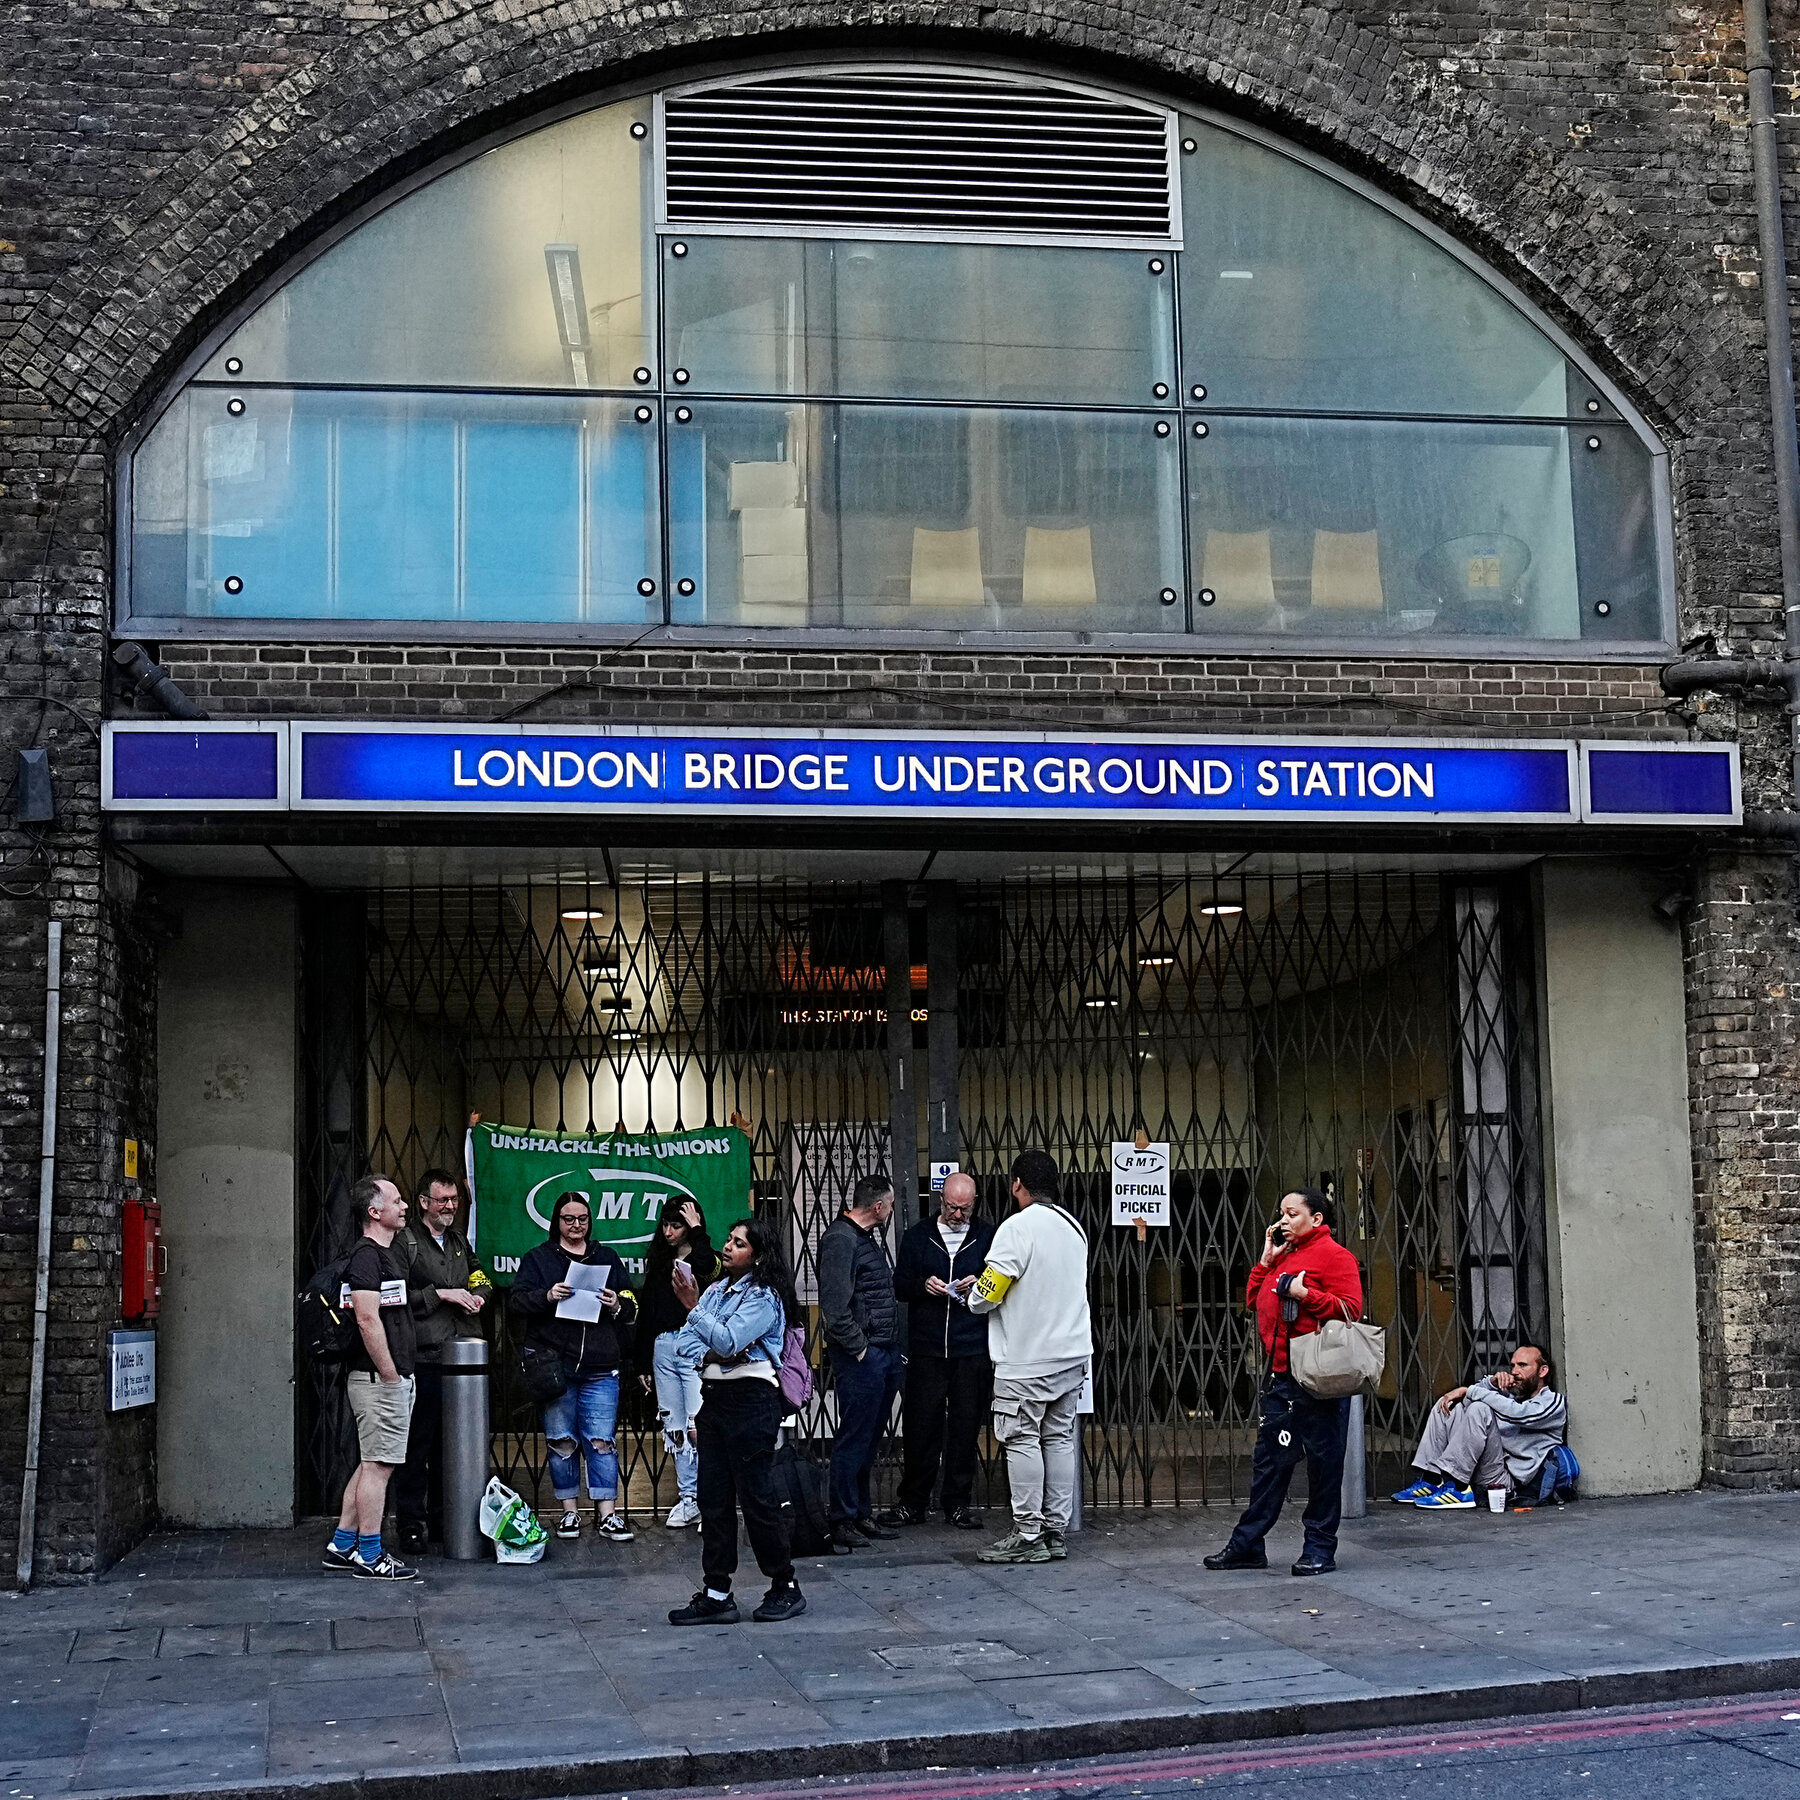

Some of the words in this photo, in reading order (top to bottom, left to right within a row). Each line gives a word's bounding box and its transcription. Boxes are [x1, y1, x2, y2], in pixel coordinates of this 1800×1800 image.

[454, 749, 659, 789] LONDON
[685, 752, 849, 791] BRIDGE
[874, 755, 1233, 796] UNDERGROUND
[1257, 759, 1435, 799] STATION
[490, 1132, 610, 1155] UNSHACKLE
[614, 1141, 651, 1158] THE
[653, 1137, 730, 1159] UNIONS
[1125, 1157, 1158, 1167] RMT
[1115, 1184, 1167, 1196] OFFICIAL
[577, 1191, 668, 1220] MT
[1120, 1202, 1162, 1214] PICKET
